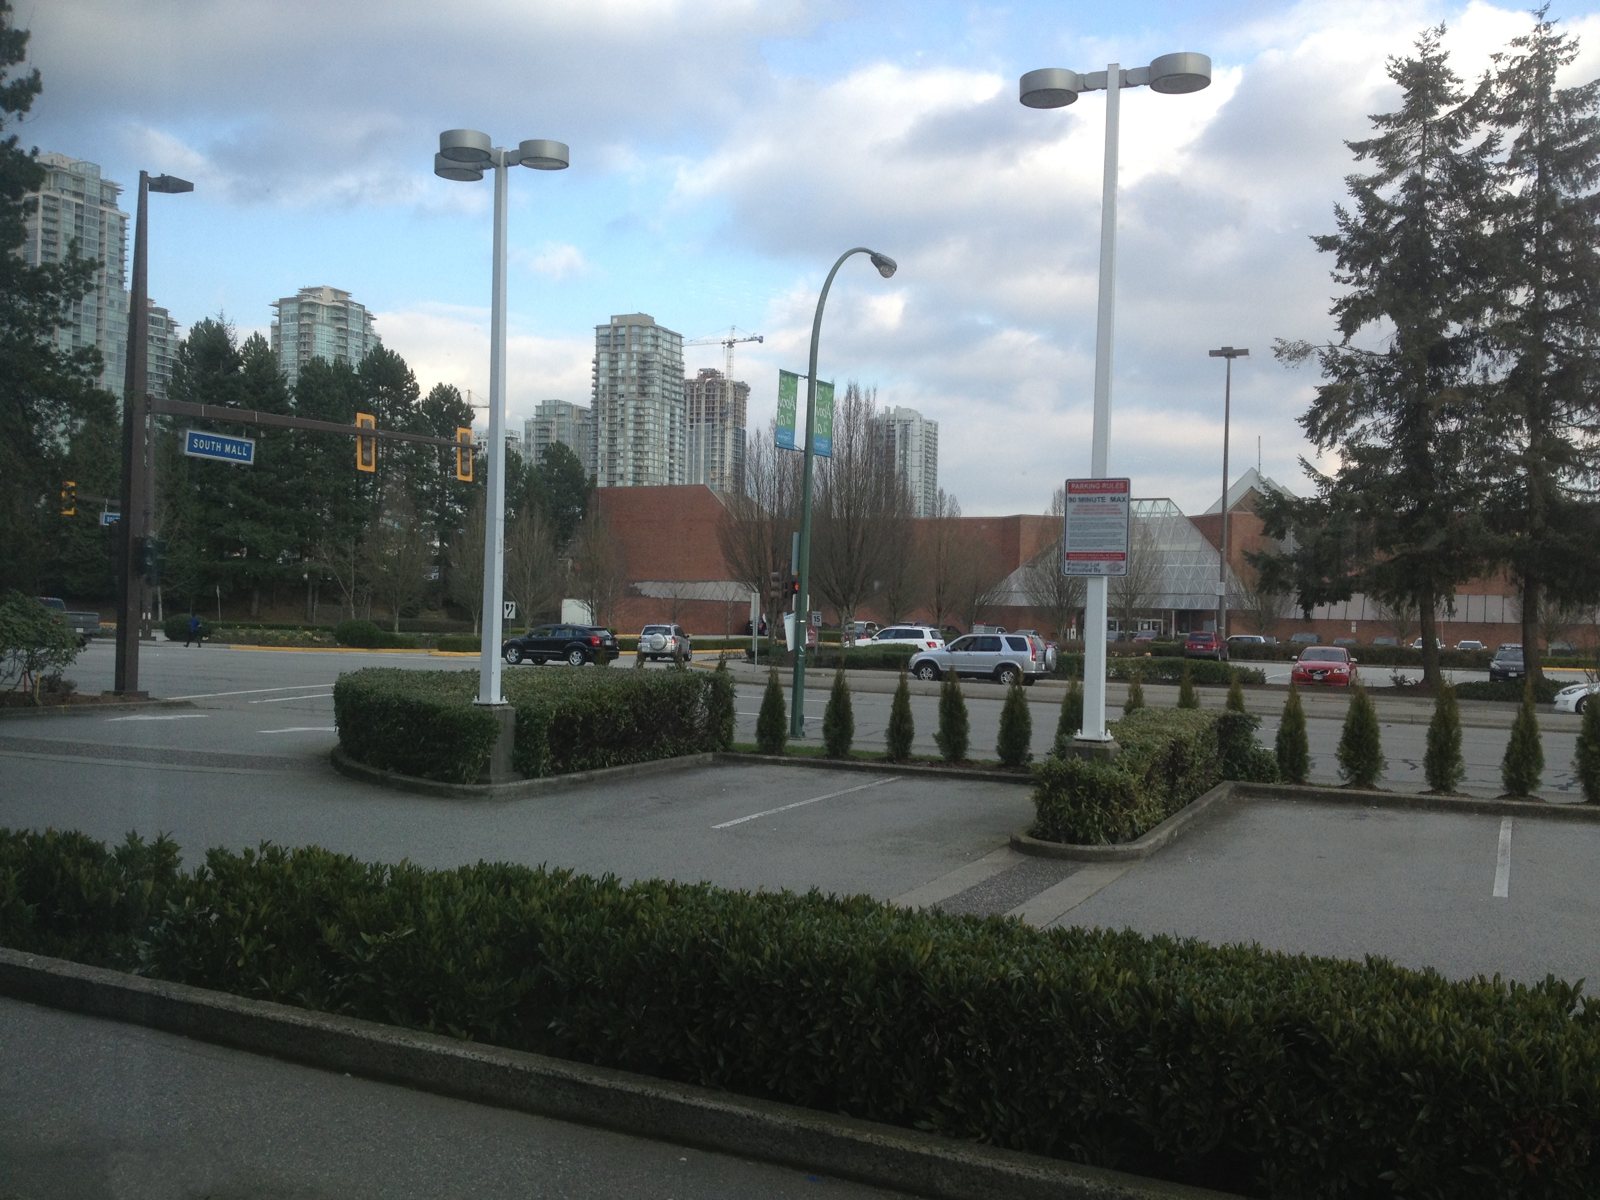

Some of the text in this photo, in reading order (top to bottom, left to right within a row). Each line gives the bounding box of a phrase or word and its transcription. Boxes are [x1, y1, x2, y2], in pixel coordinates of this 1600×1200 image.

[193, 438, 248, 456] SOUTH MALL
[1071, 481, 1125, 490] PARKING RULES
